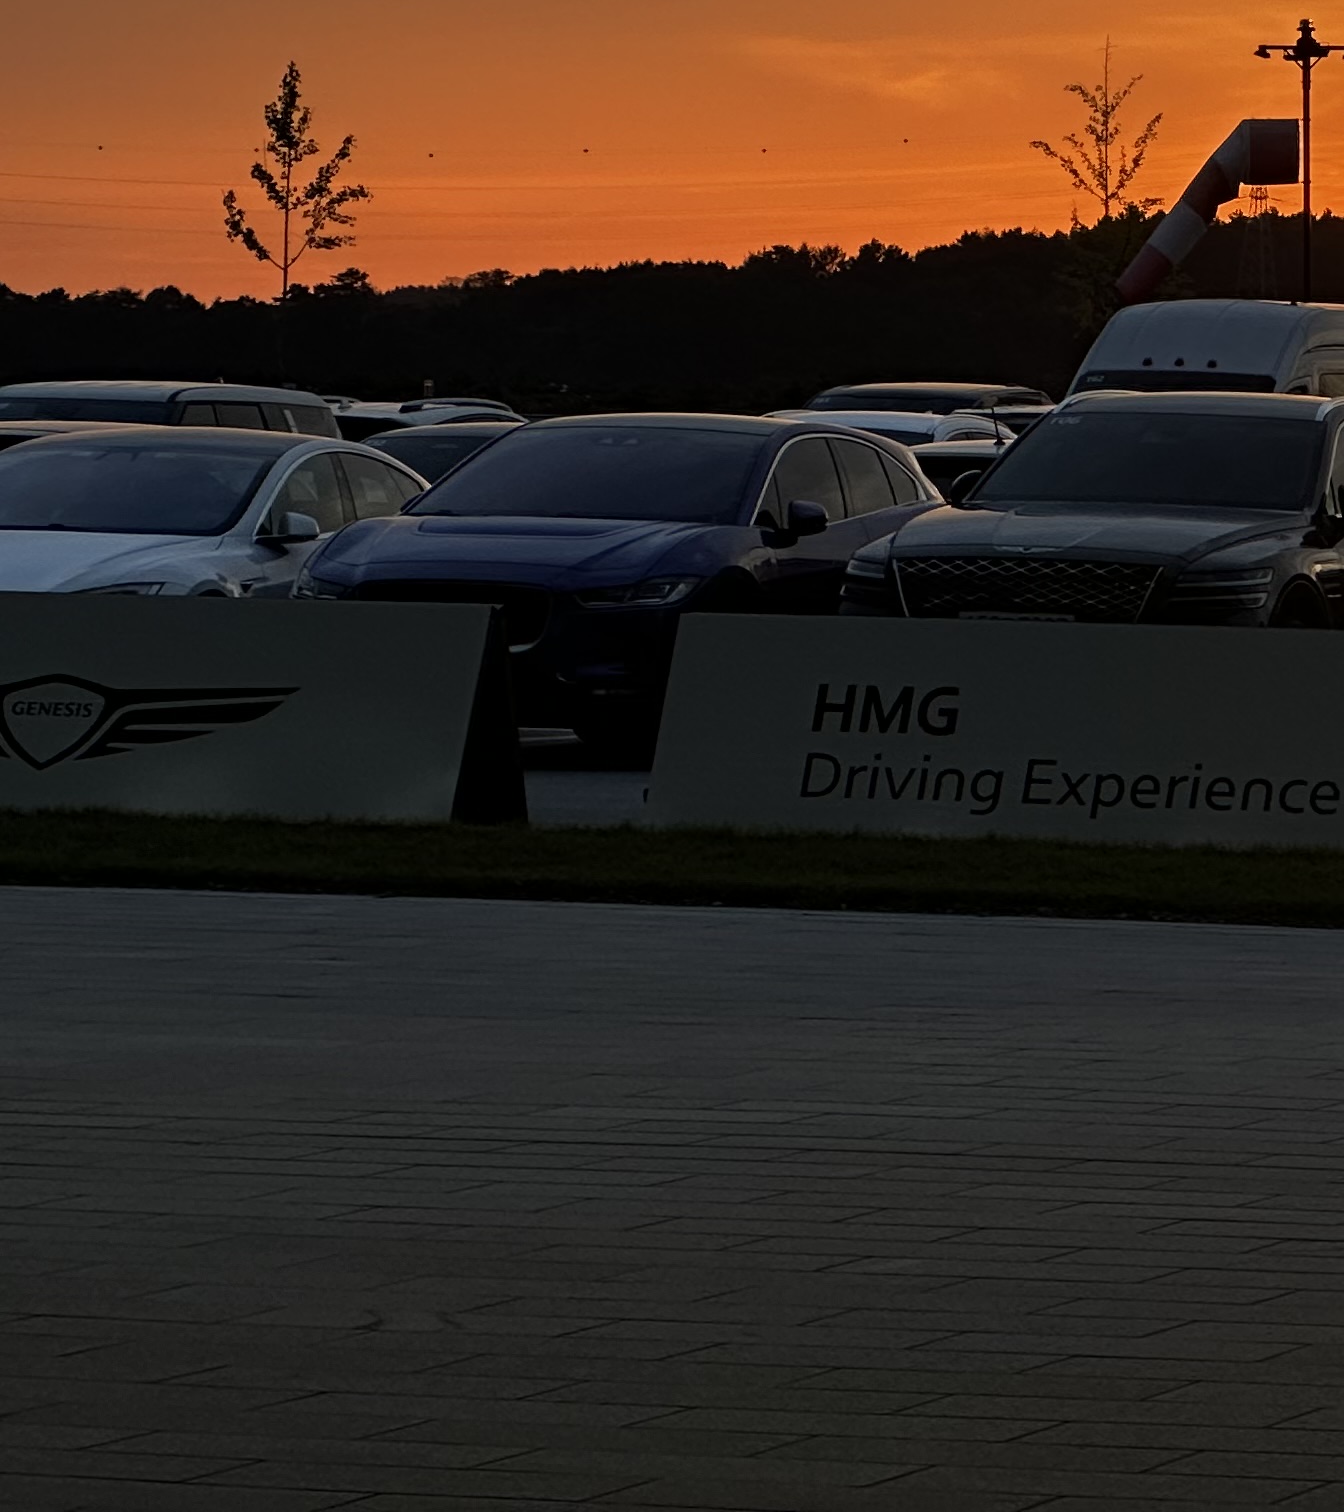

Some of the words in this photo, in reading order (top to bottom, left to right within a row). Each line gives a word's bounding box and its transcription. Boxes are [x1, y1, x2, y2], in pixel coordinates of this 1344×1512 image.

[11, 700, 93, 718] GENESIS
[811, 683, 960, 736] HMG
[799, 752, 1005, 816] Driving
[1020, 757, 1342, 819] Experience
